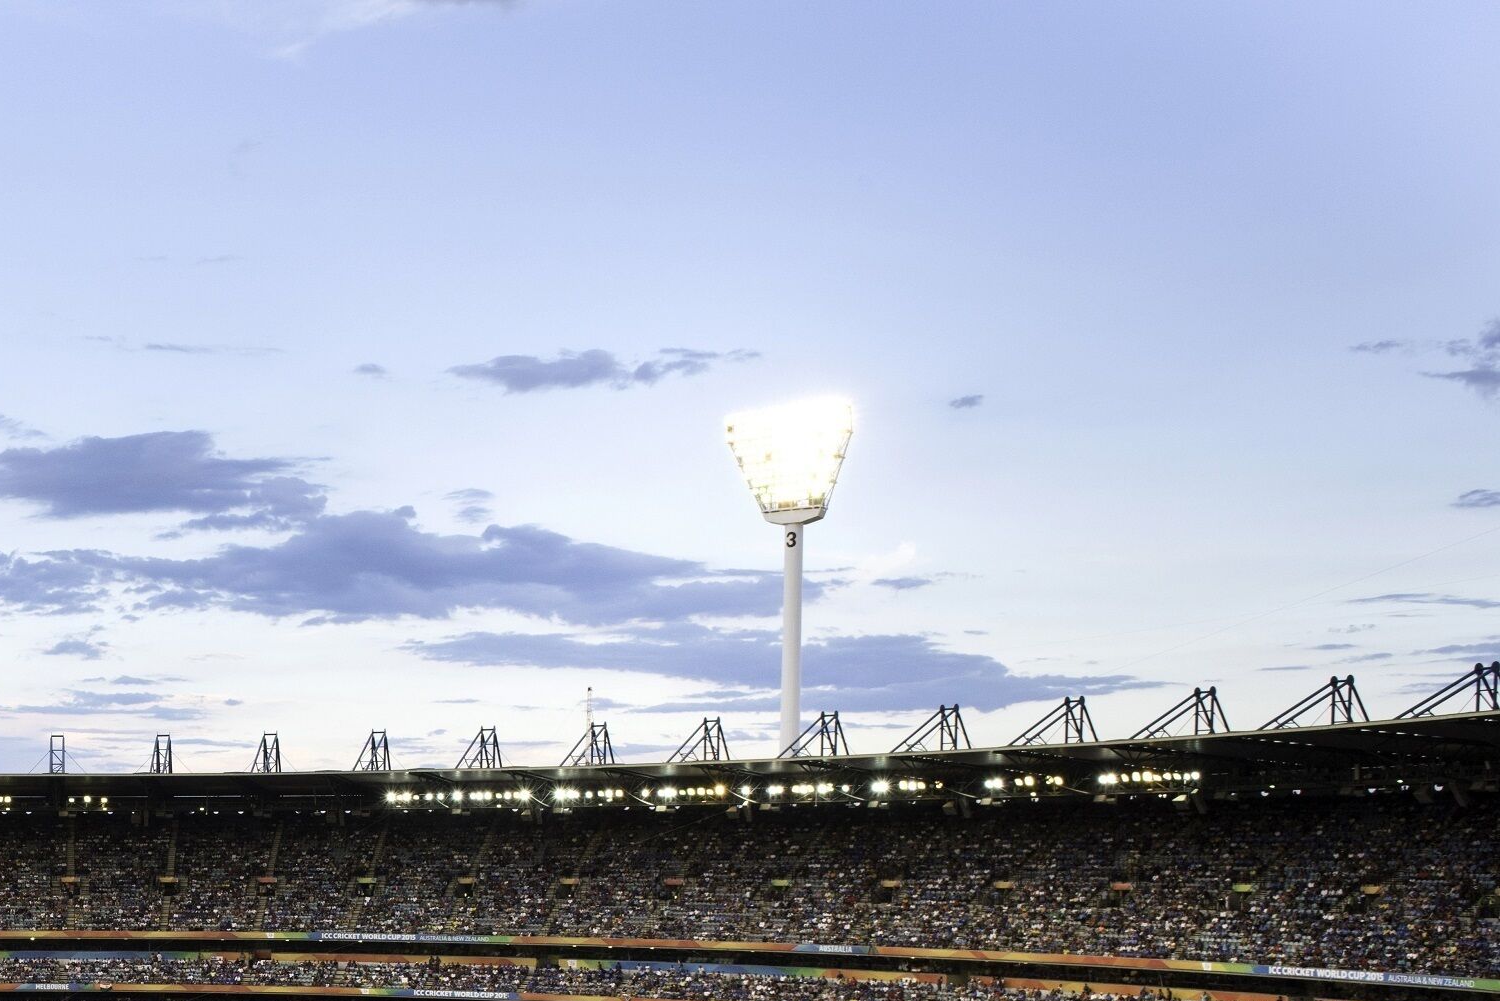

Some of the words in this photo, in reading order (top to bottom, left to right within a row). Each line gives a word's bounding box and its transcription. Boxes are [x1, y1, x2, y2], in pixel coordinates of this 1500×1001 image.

[786, 532, 797, 548] 3
[1282, 966, 1315, 977] CRICKET
[1316, 969, 1347, 979] WORLD
[1348, 971, 1365, 980] CUP
[1365, 972, 1384, 982] 2015
